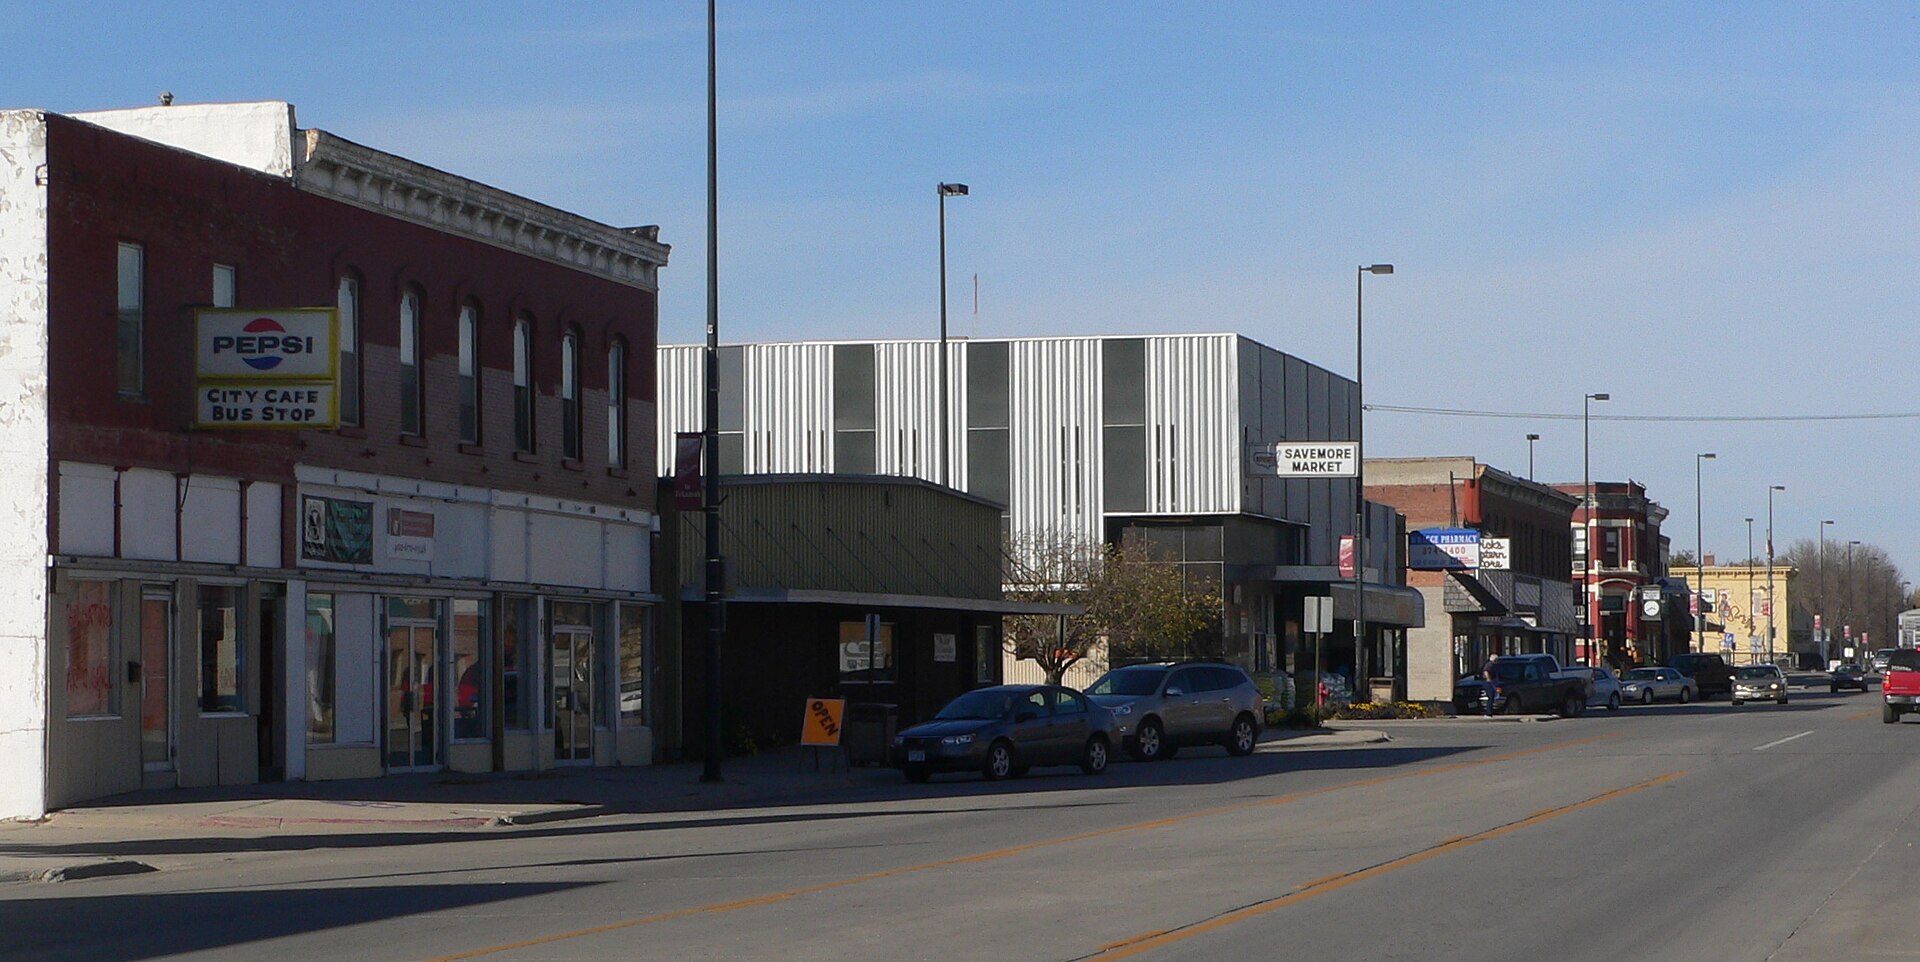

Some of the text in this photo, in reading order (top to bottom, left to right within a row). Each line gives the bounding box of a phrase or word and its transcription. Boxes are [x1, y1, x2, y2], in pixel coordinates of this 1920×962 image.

[213, 335, 313, 354] PEPSI
[207, 389, 319, 403] CITY CAFE
[212, 405, 316, 421] BUS STOP
[1284, 448, 1352, 459] SAVEMORE
[1292, 461, 1342, 472] MARKET
[1440, 535, 1477, 544] PHARMACY
[811, 700, 839, 737] OPEN
